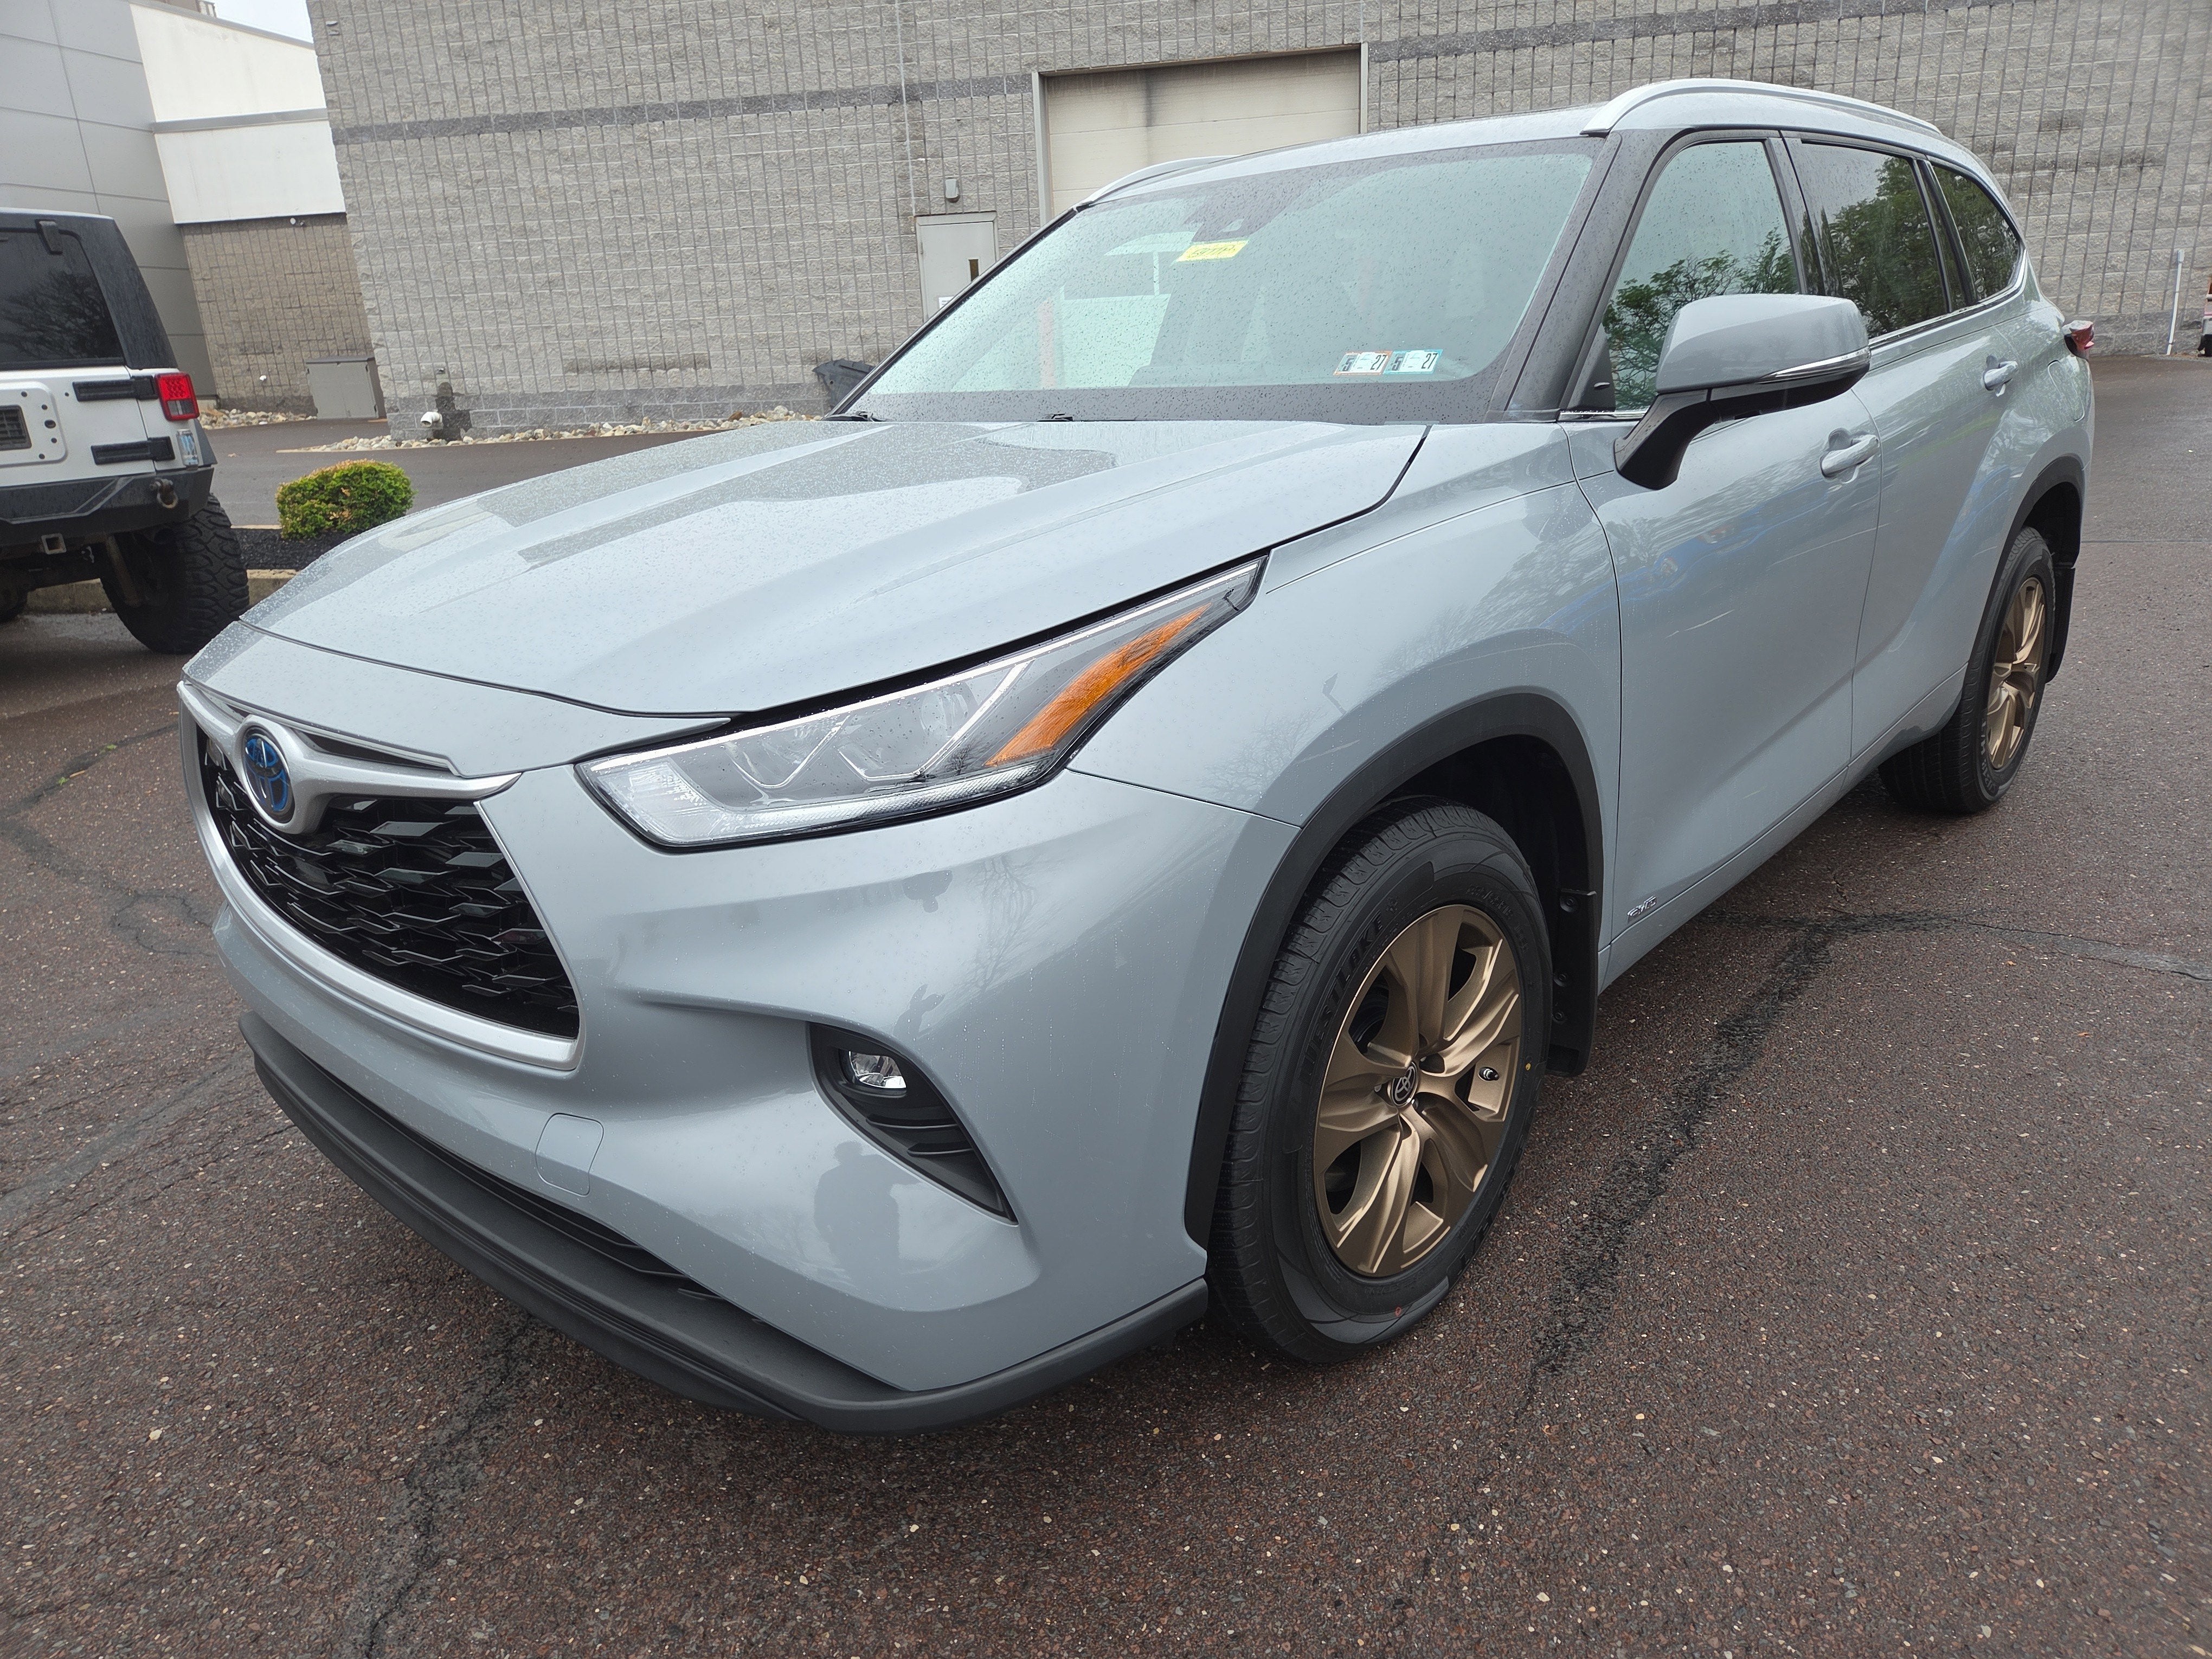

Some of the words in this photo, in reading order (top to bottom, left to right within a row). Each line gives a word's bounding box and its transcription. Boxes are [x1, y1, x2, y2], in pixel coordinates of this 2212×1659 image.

[1342, 357, 1354, 372] 5
[1370, 355, 1387, 370] 27
[1392, 356, 1403, 371] 5
[1421, 353, 1438, 369] 27
[1300, 911, 1384, 1077] WESTLAKE
